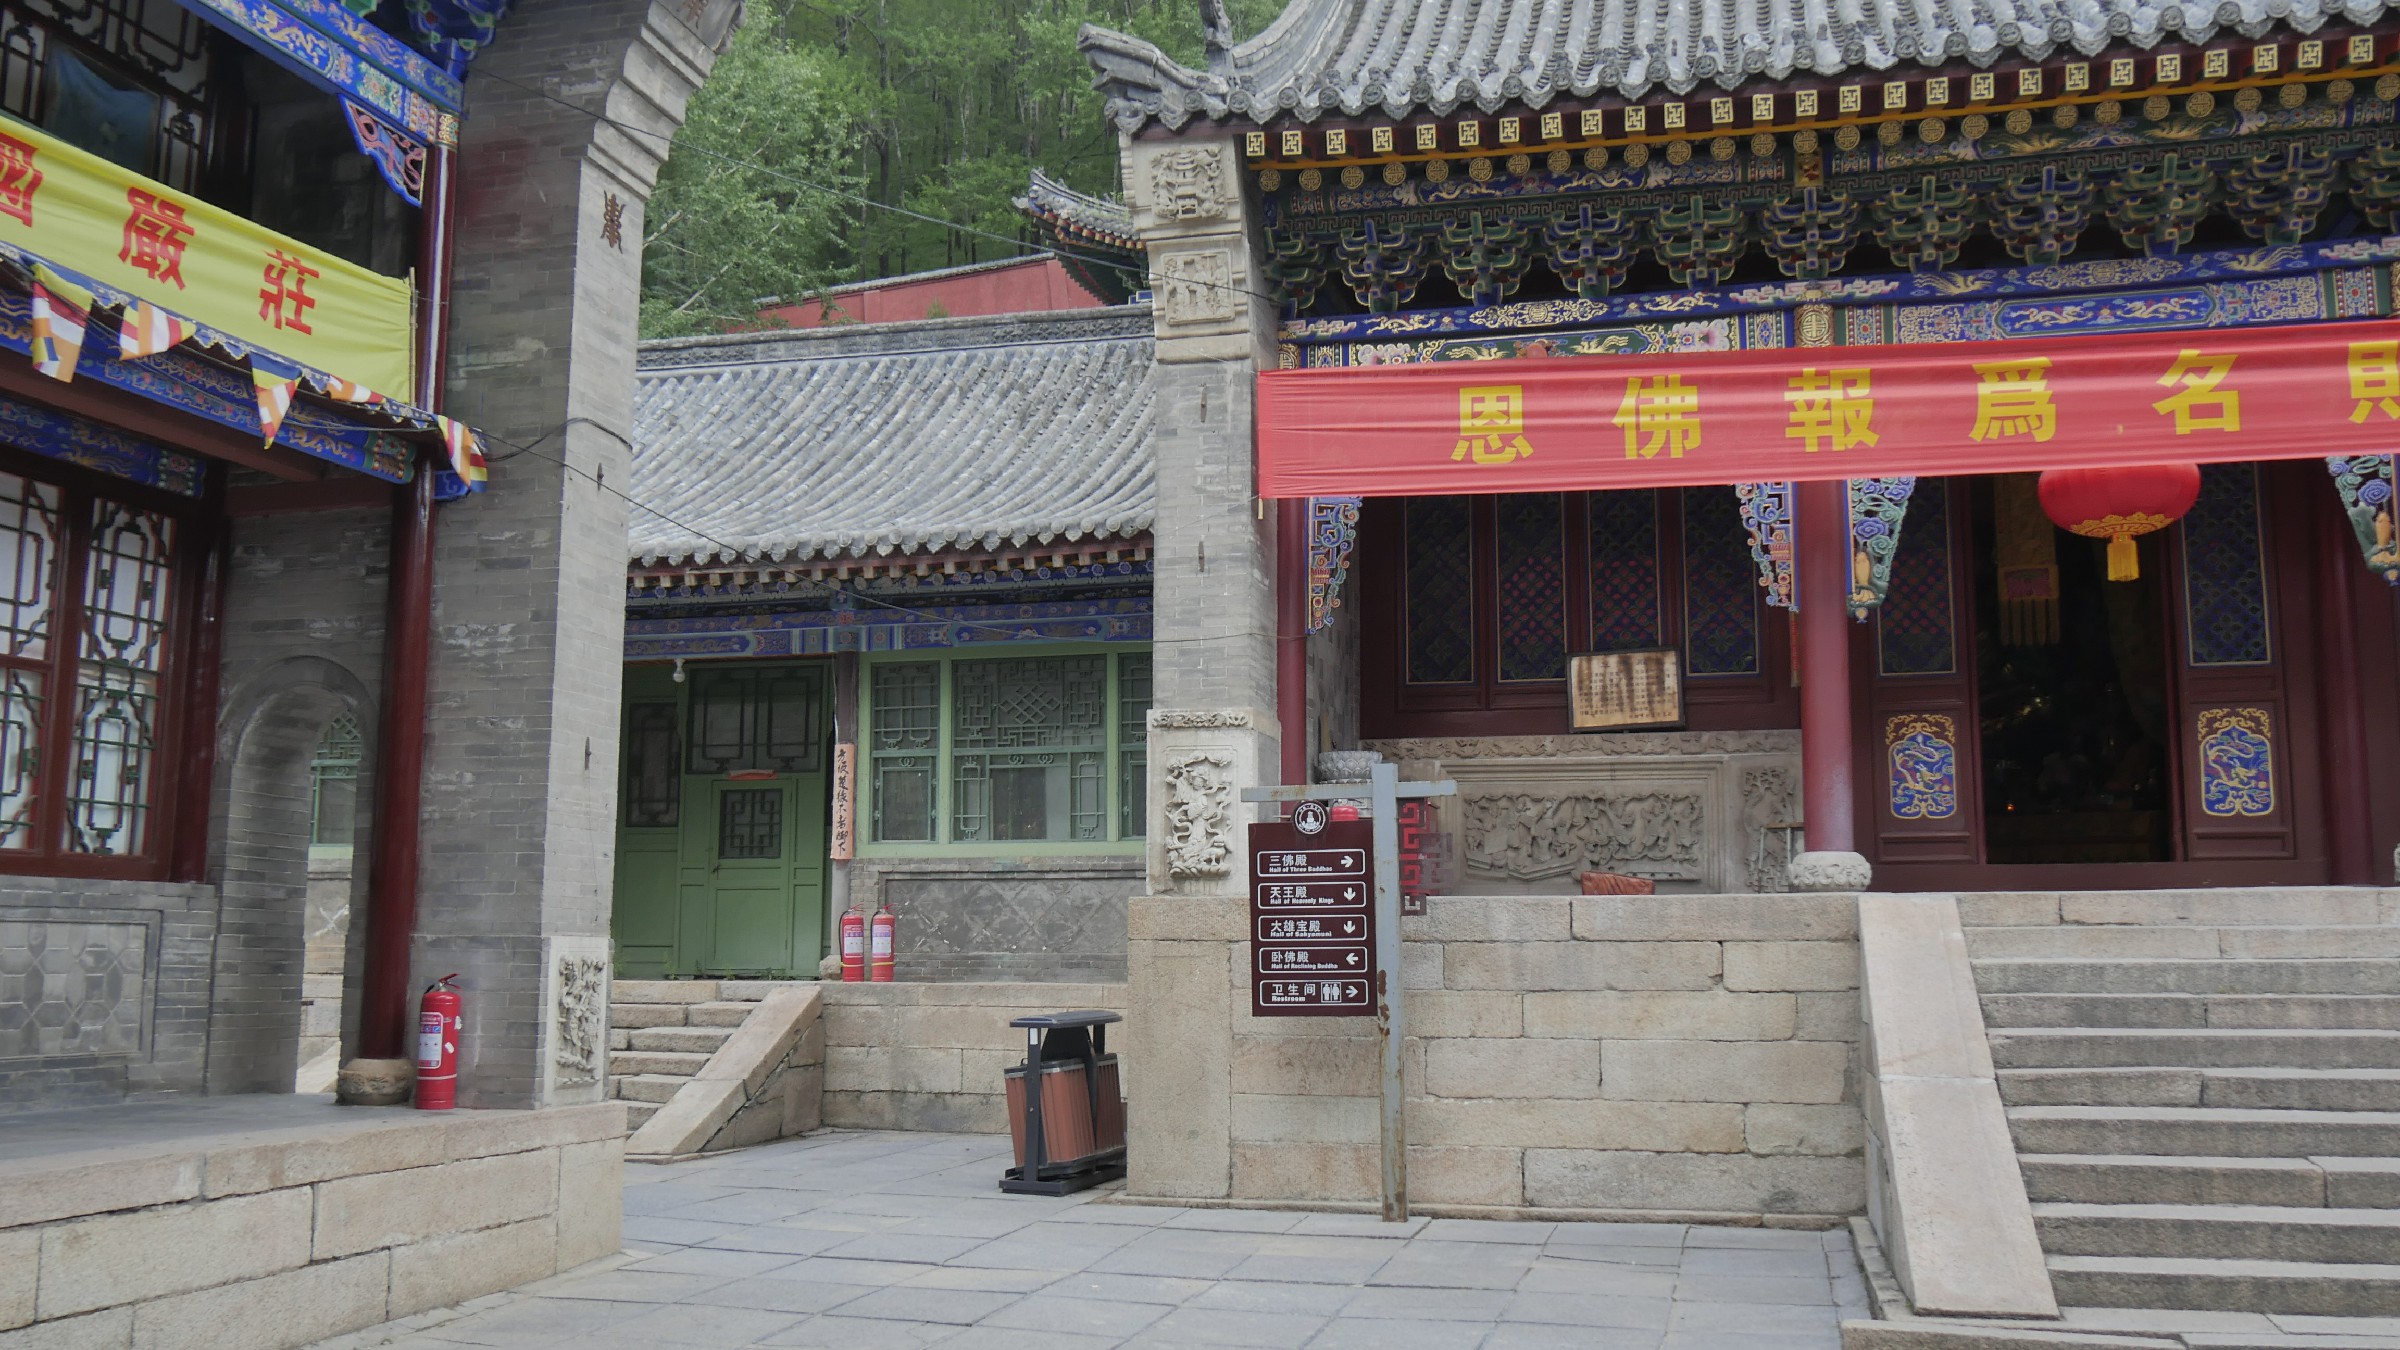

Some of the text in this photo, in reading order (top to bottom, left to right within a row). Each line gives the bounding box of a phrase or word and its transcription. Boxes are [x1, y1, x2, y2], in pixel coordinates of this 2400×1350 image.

[1269, 854, 1307, 866] 三佛殿
[1270, 886, 1307, 898] 天王殿
[1271, 920, 1320, 932] 大雄宝殿
[1271, 951, 1309, 962] 卧佛殿
[1271, 983, 1316, 996] 卫生间
